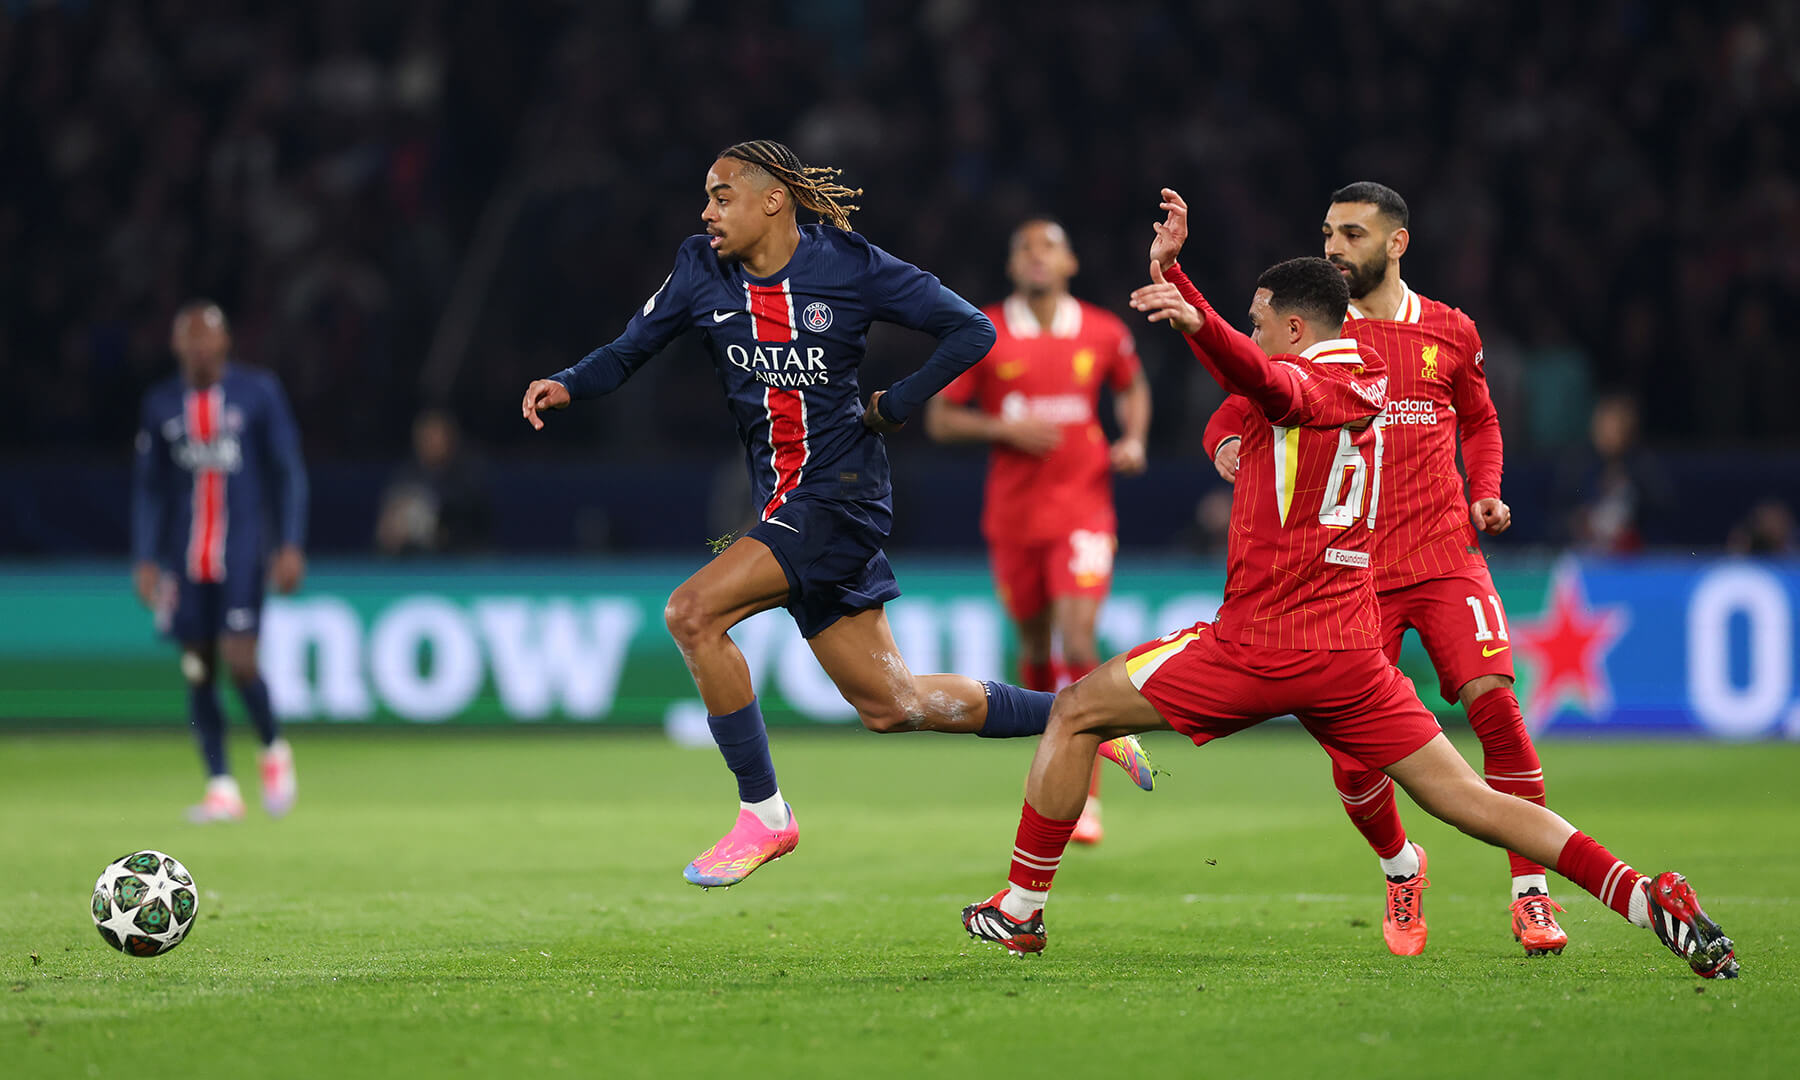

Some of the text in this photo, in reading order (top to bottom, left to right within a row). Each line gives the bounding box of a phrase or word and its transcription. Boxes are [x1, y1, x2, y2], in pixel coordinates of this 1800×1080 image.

[726, 344, 827, 372] QATAR
[756, 370, 829, 387] AIRWAYS
[1421, 367, 1439, 380] LFC
[1388, 398, 1433, 412] ndard
[1385, 412, 1437, 424] artered
[1465, 594, 1509, 642] 11
[258, 596, 642, 722] now
